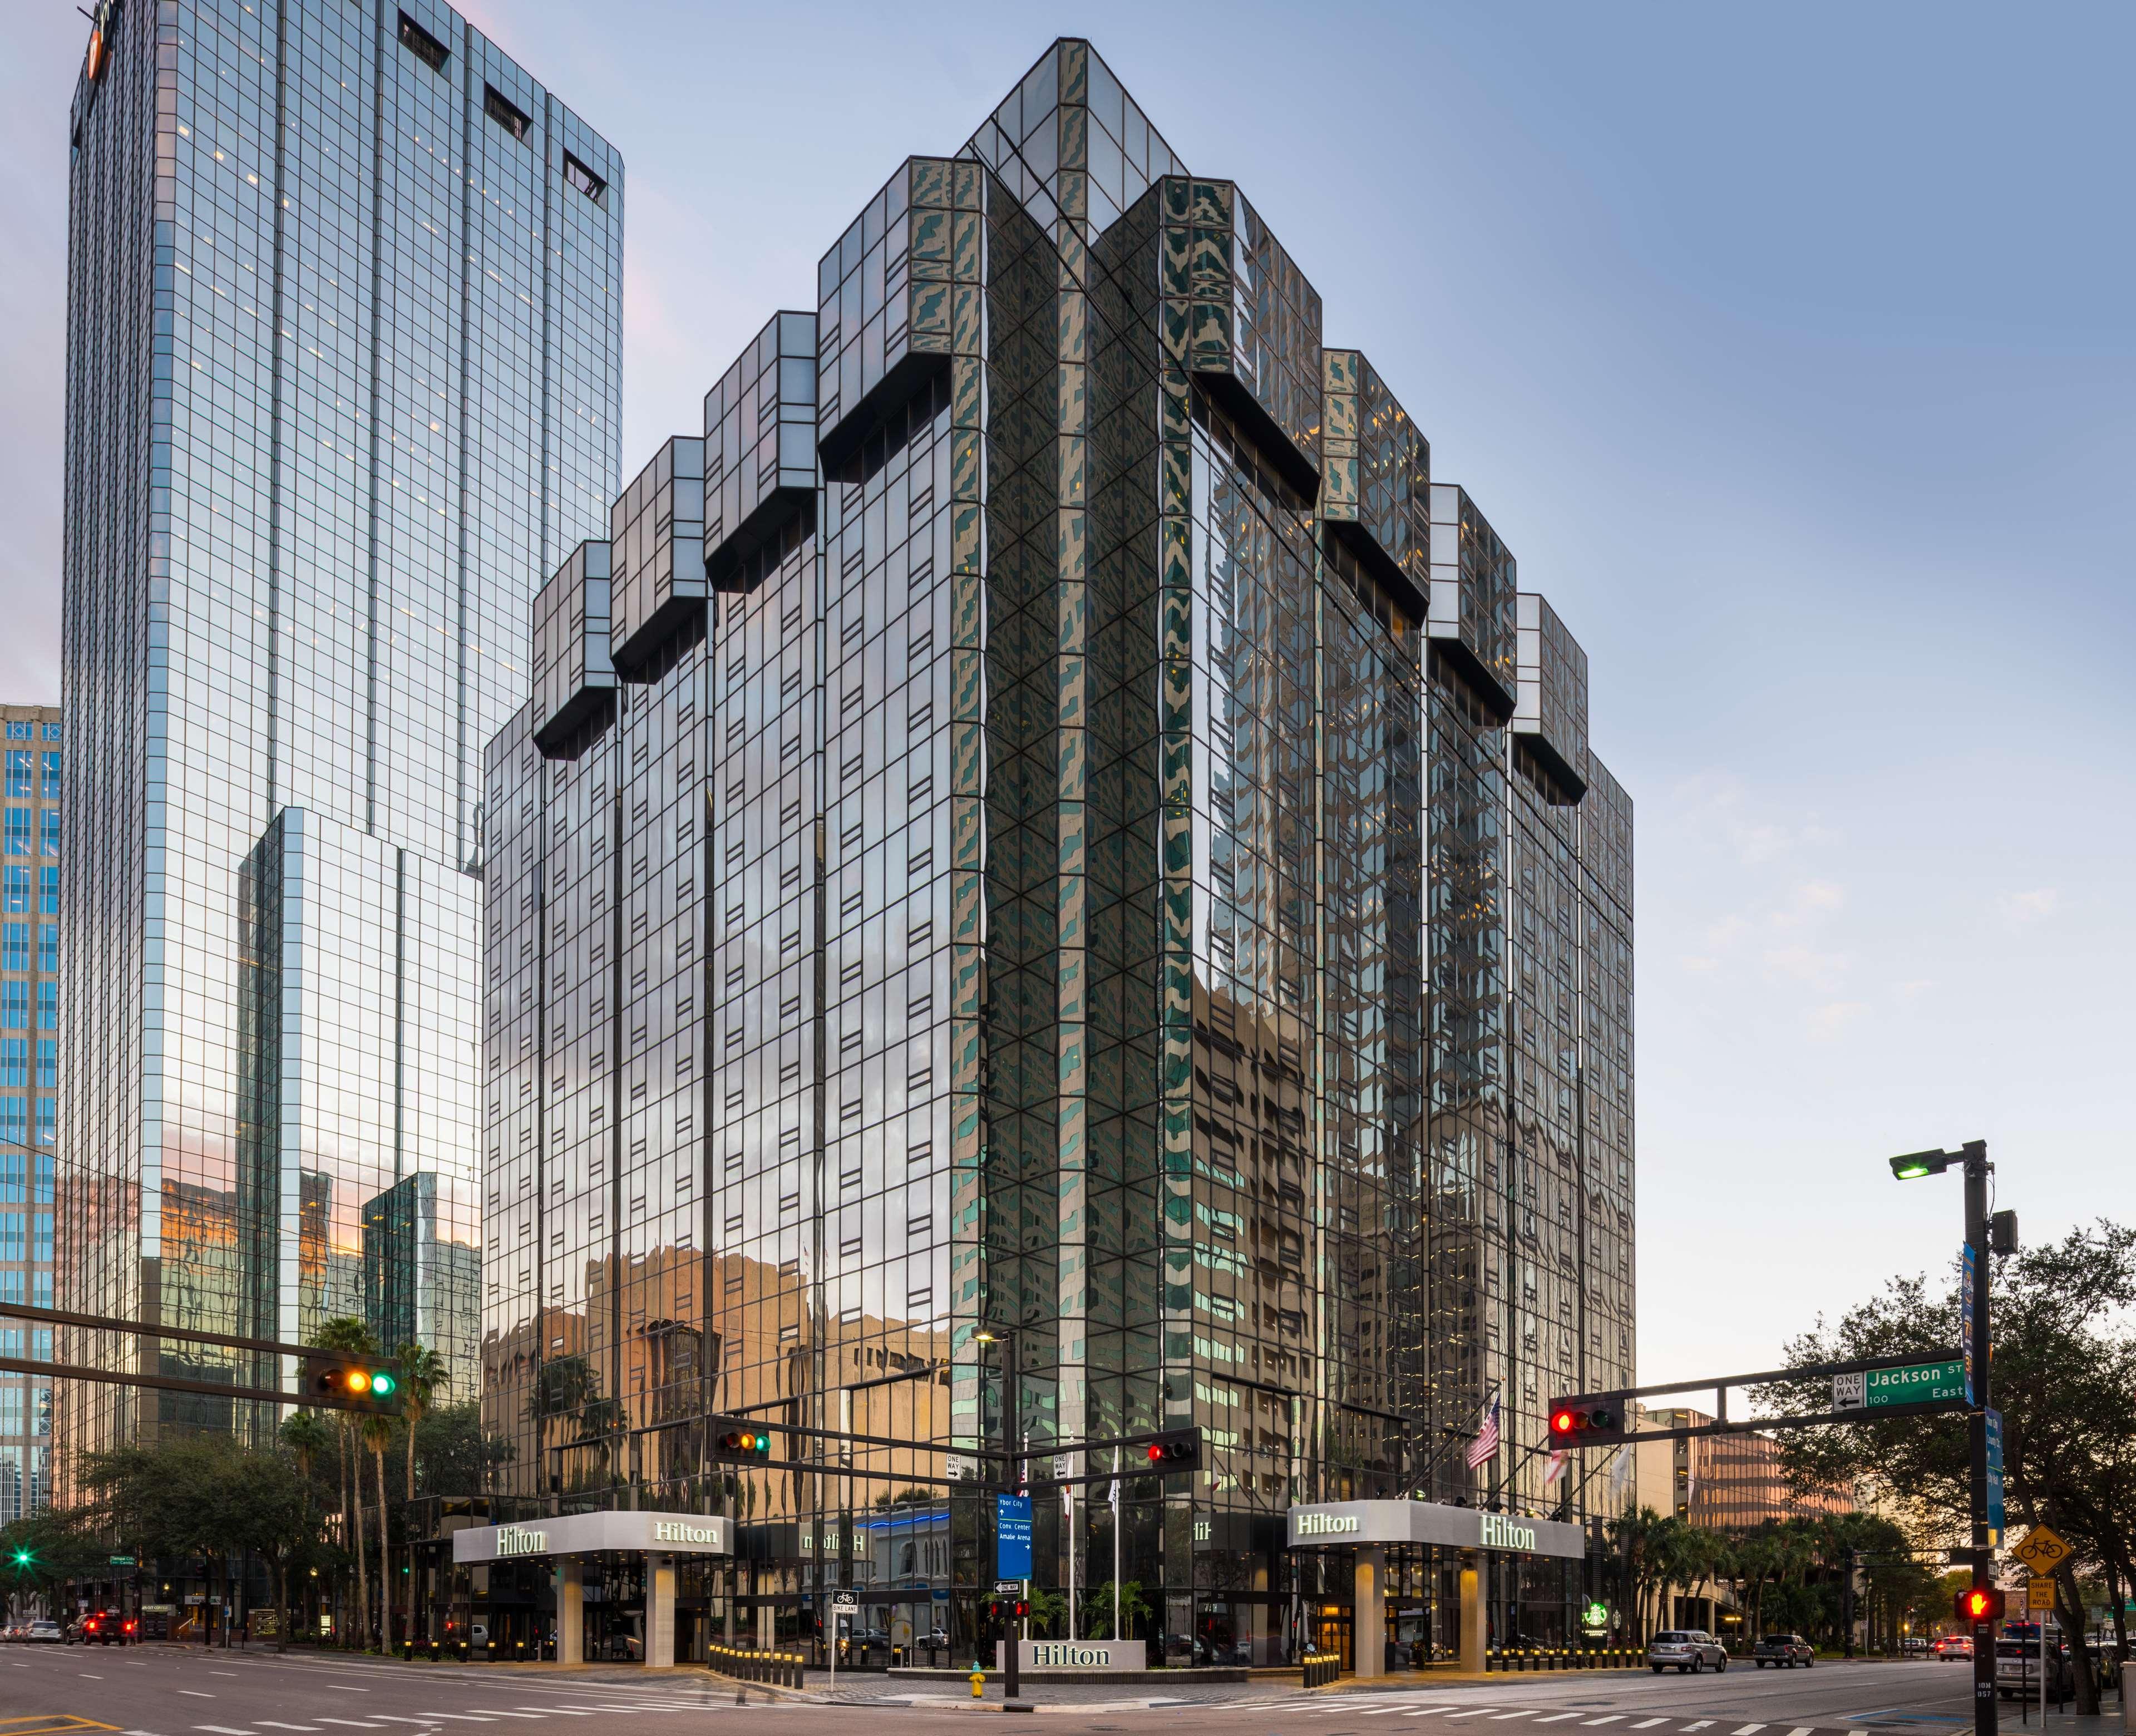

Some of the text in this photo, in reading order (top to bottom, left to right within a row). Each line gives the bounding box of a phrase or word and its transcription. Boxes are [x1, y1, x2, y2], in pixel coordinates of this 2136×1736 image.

[1837, 1375, 1860, 1385] ONE
[1869, 1365, 1962, 1387] Jackson ST
[1836, 1385, 1861, 1397] WAY
[1869, 1387, 1963, 1404] 100 East
[1013, 1500, 1023, 1508] City
[655, 1522, 718, 1543] Hilton
[1297, 1513, 1358, 1535] Hilton
[1479, 1515, 1536, 1550] Hilton
[496, 1526, 546, 1556] Hilton
[1033, 1645, 1110, 1665] Hilton
